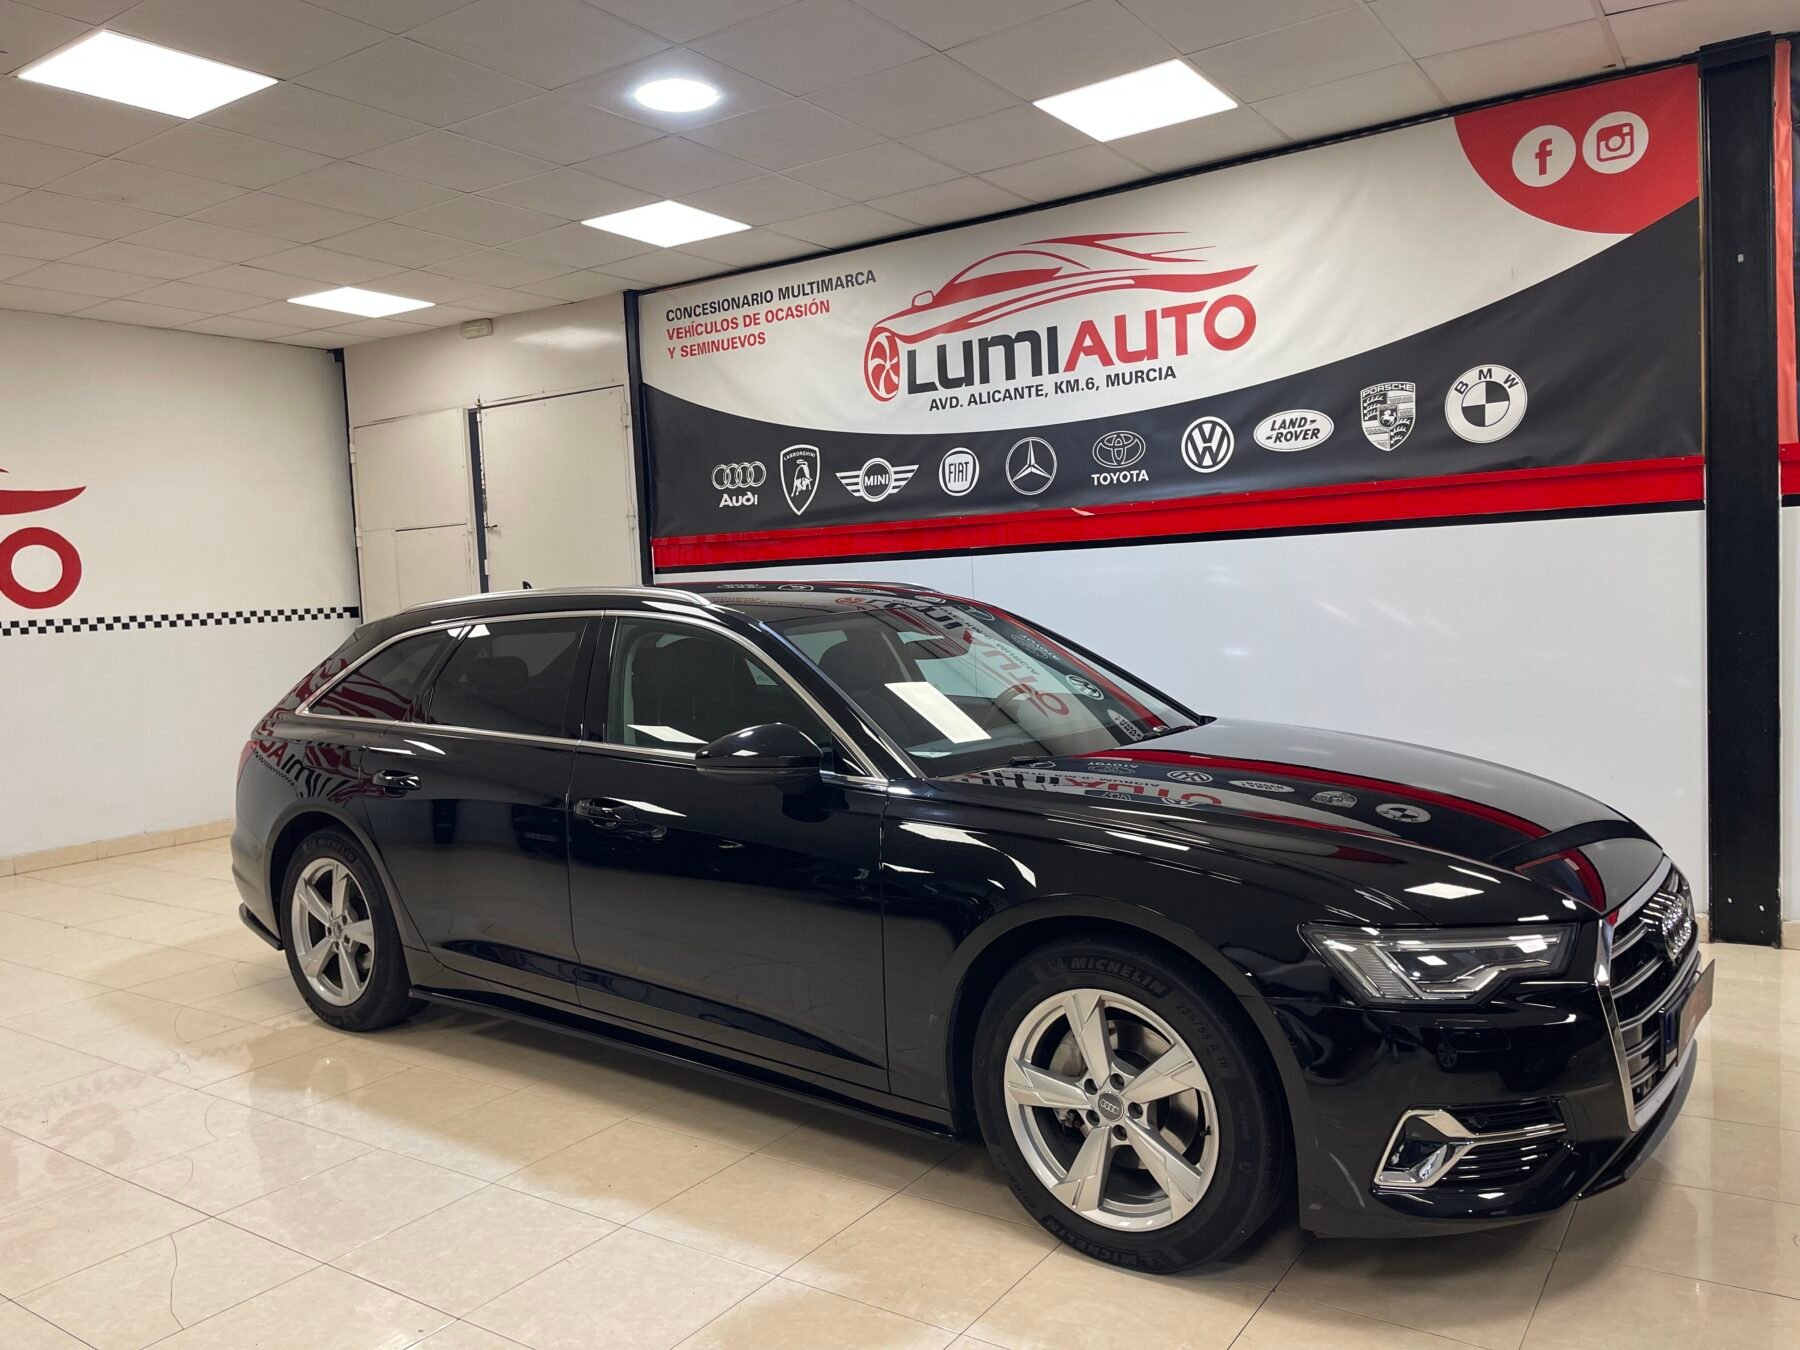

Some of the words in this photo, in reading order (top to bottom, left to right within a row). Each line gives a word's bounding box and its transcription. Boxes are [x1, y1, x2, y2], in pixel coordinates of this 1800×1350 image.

[666, 290, 774, 322] CONCESIONARIO
[778, 269, 876, 301] MULTIMARCA
[666, 317, 739, 341] VEHÍCULOS
[743, 313, 761, 328] DE
[765, 298, 830, 324] OCASIÓN
[667, 347, 676, 359] Y
[680, 332, 766, 358] SEMINUEVOS
[929, 396, 963, 412] AVD.
[967, 384, 1049, 407] ALICANTE,
[1054, 377, 1100, 396] KM.6,
[1105, 366, 1177, 387] MURCIA
[1362, 382, 1414, 398] PORSCHE
[864, 472, 889, 487] MINI
[944, 460, 970, 485] FIAT
[1091, 469, 1149, 486] TOYOTA
[1070, 957, 1169, 995] MICHELIN
